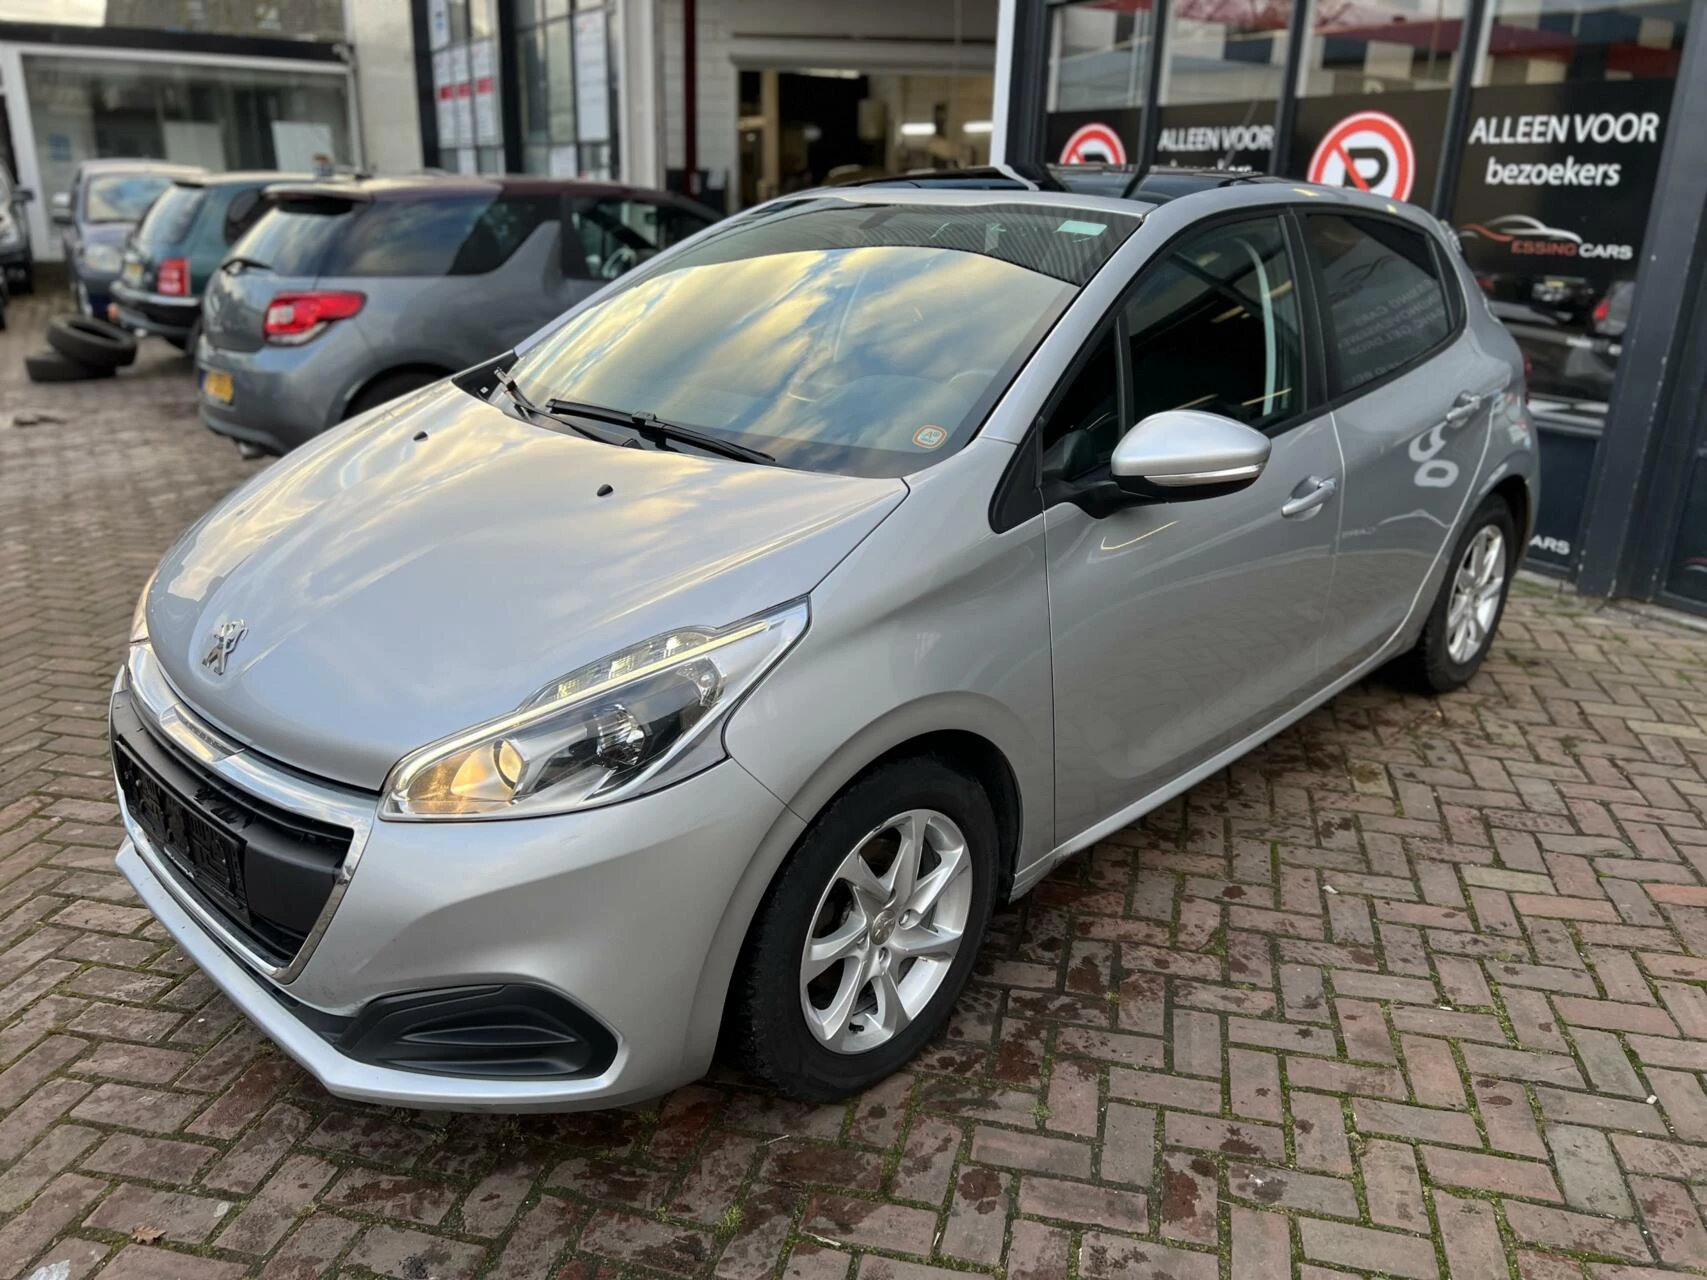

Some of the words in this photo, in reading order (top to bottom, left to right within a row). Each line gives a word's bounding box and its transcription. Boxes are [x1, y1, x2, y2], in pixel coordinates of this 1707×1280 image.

[1157, 126, 1219, 150] ALLEEN
[1221, 125, 1275, 149] VOOR
[1468, 116, 1571, 143] ALLEEN
[1574, 112, 1659, 143] VOOR
[1485, 156, 1621, 186] bezoekers
[1578, 242, 1633, 260] CARS
